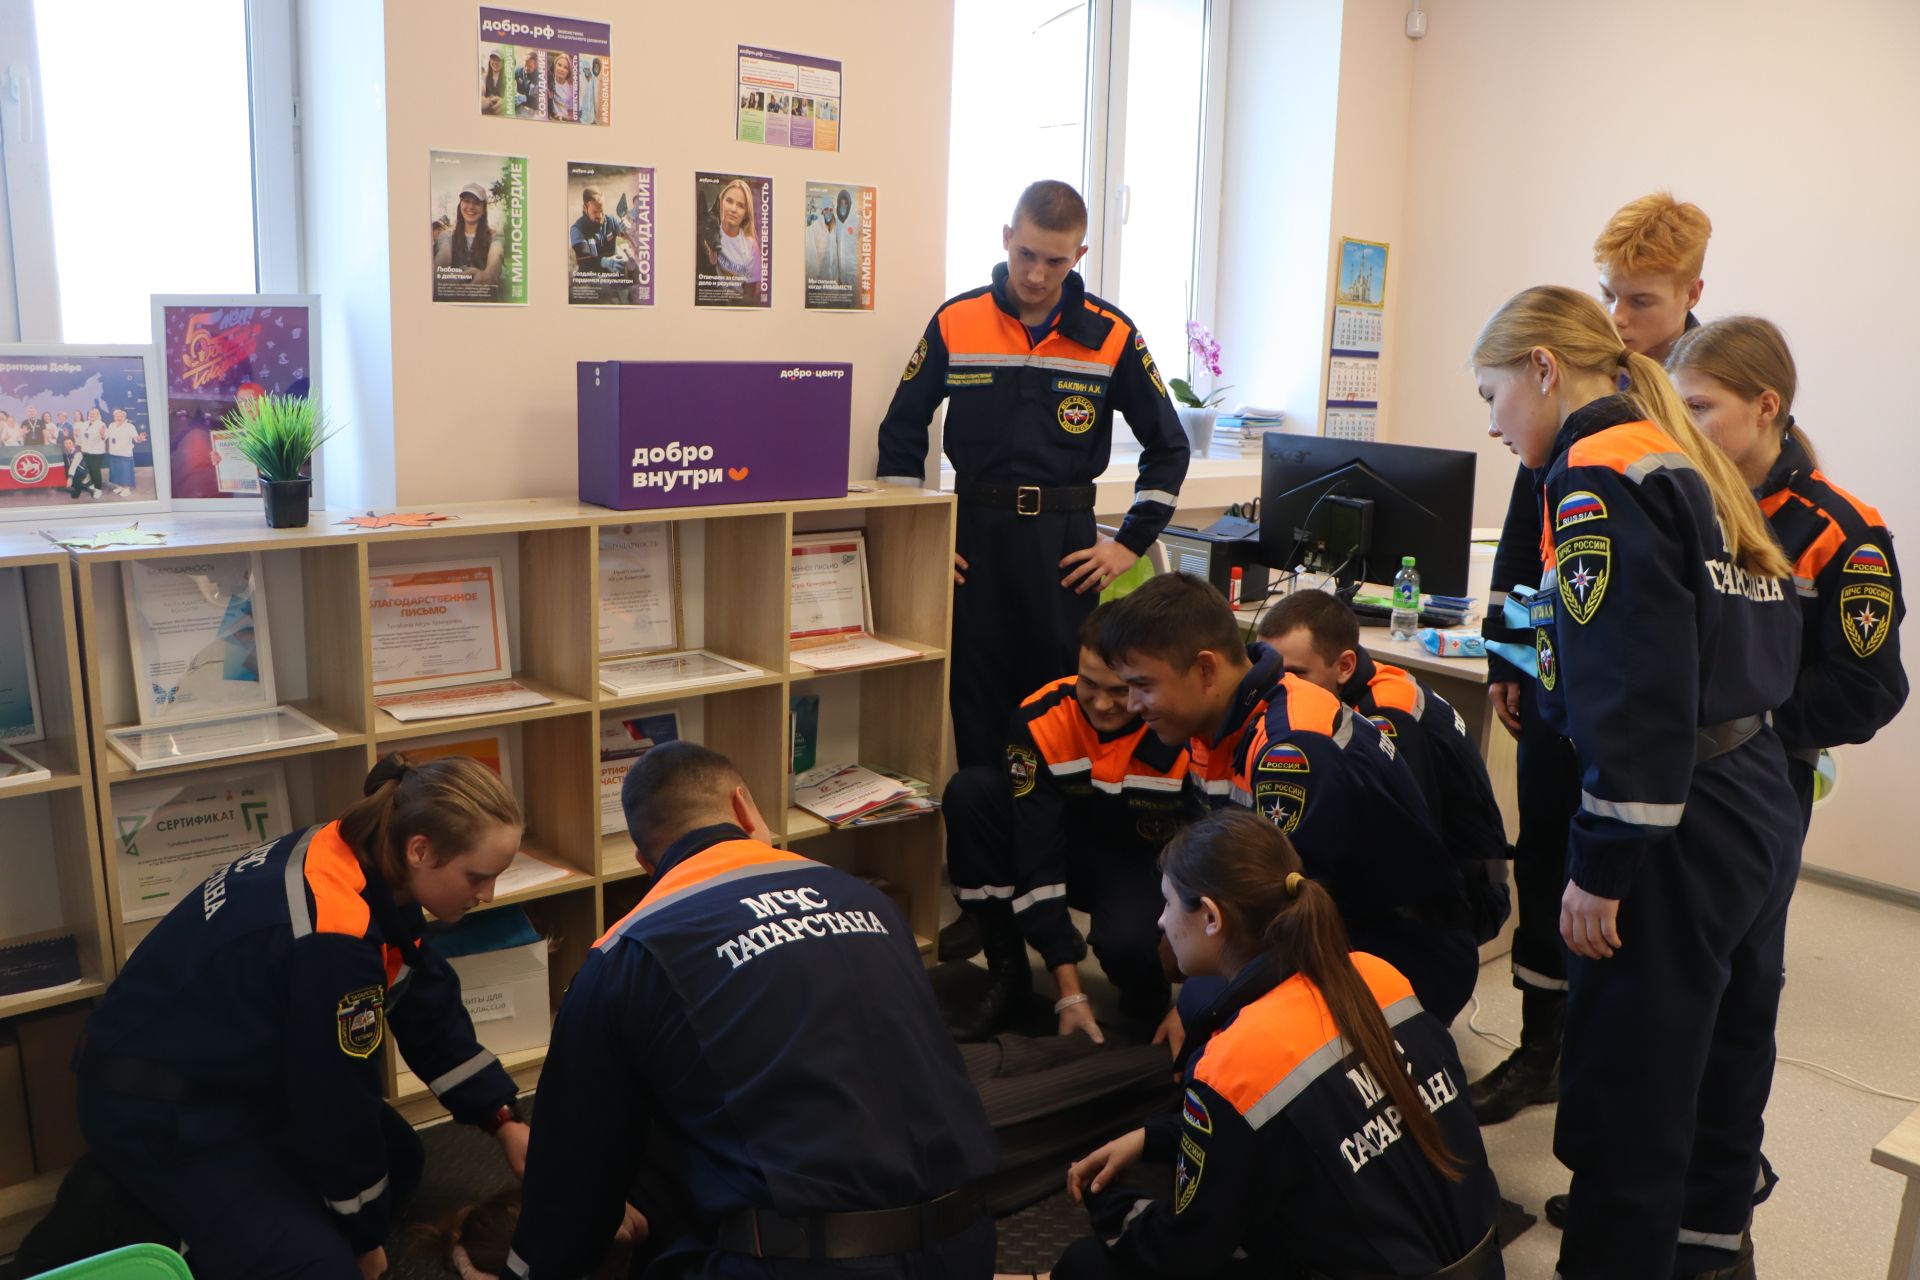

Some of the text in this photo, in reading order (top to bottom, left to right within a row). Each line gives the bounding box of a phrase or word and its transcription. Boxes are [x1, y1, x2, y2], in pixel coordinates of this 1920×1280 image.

[482, 19, 555, 39] добро.рф
[538, 50, 546, 117] СОЗИДАНИЕ
[602, 57, 610, 123] #МЫВМЕСТЕ
[511, 163, 523, 282] МИЛОСЕРДИЕ
[638, 172, 651, 285] СОЗИДАНИЕ
[760, 182, 769, 292] ОТВЕТСТВЕННОСТЬ
[861, 191, 873, 290] #МЫВМЕСТЕ
[0, 363, 48, 373] рритория
[780, 368, 844, 379] добро центр
[1058, 380, 1087, 391] БАКЛИН
[632, 441, 714, 467] добро
[632, 467, 723, 492] внутри
[1562, 511, 1594, 526] RUSSIA
[1574, 540, 1606, 552] РОССИИ
[1852, 563, 1884, 573] РОССИЯ
[1844, 586, 1891, 600] МЧС РОССИИ
[401, 606, 447, 618] ПИСЬМО
[1266, 761, 1300, 770] РОССИЯ
[1274, 783, 1304, 796] РОССИИ
[156, 810, 235, 832] СЕРТИФИКАТ
[740, 887, 828, 919] МЧС
[716, 911, 889, 969] ТАТАРСТАНА
